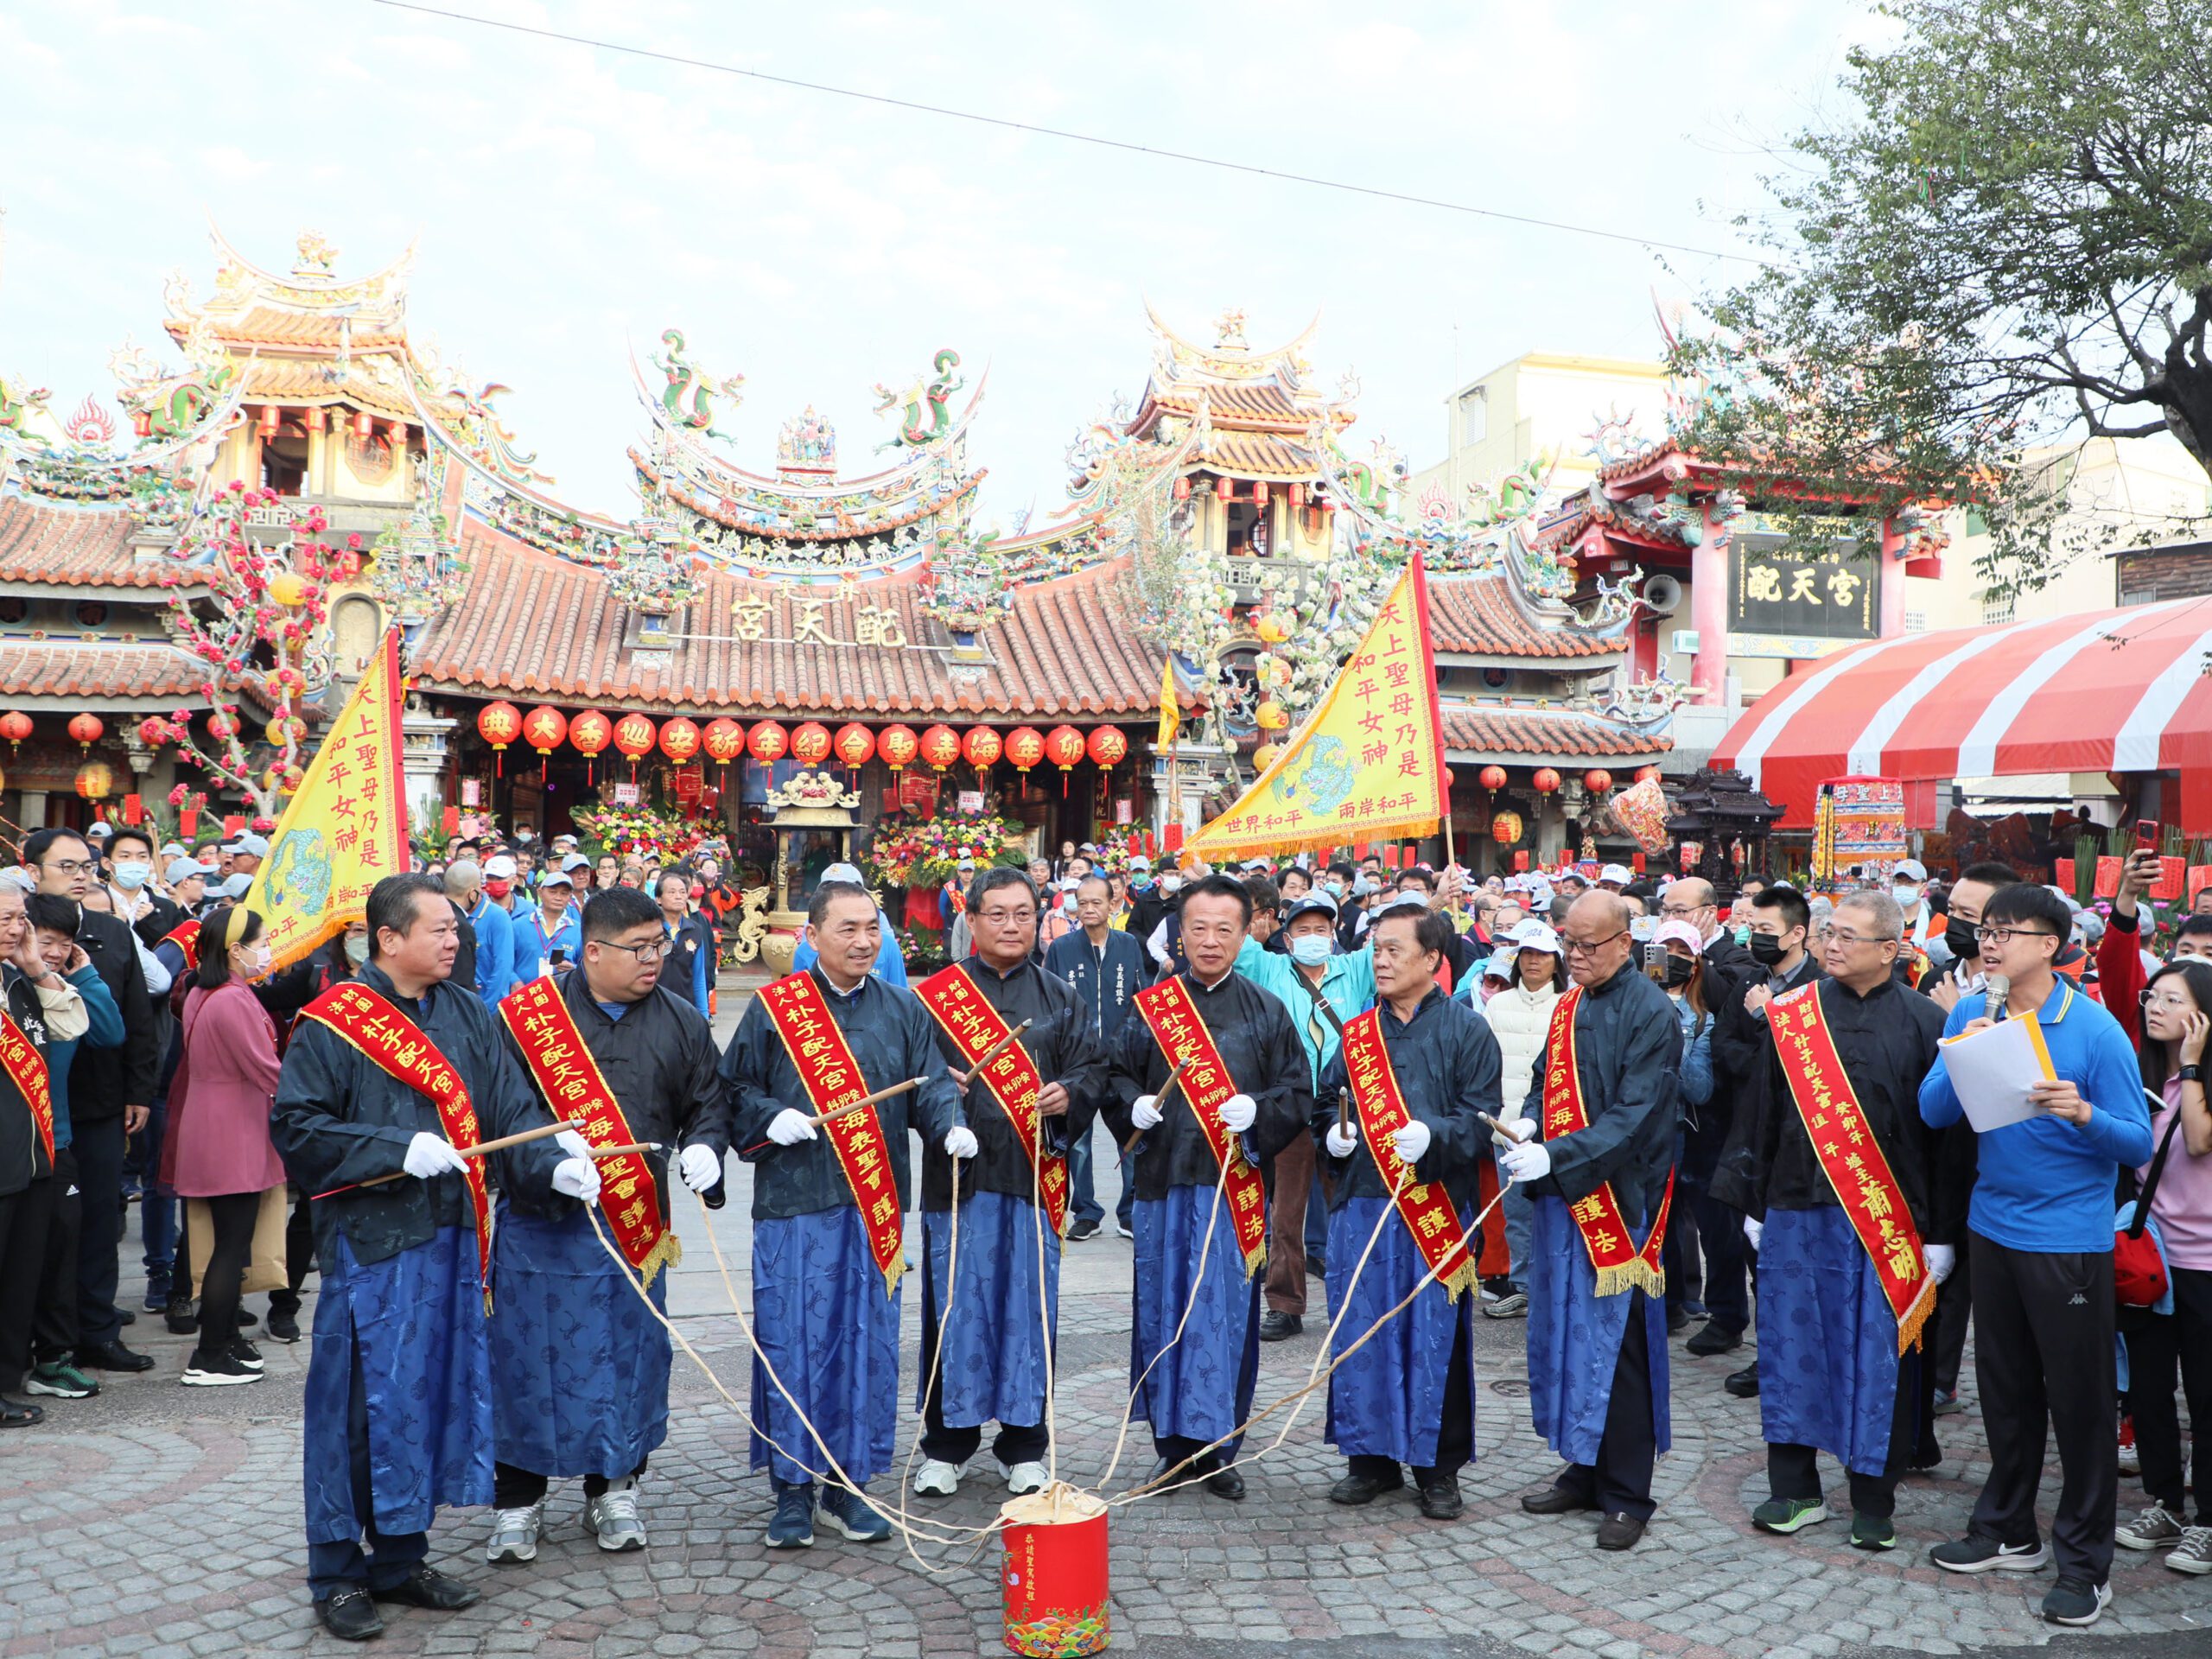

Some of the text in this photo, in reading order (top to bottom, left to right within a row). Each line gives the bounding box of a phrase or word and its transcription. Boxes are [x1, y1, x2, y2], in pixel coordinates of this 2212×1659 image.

[1747, 564, 1861, 607] 配天宮
[1353, 653, 1389, 767] 和平女神
[1380, 602, 1423, 779] 天上聖母乃是
[327, 736, 358, 853] 和平女神
[353, 683, 385, 868] 天上聖母乃是
[1224, 809, 1303, 834] 世界和平
[1338, 791, 1418, 820] 兩岸和平
[1524, 927, 1542, 938] 2024
[340, 988, 374, 1014] 財團
[511, 995, 532, 1016] 法人
[528, 982, 550, 1007] 財團
[771, 985, 794, 1007] 法人
[789, 980, 810, 1000] 財團
[934, 990, 956, 1012] 法人
[948, 979, 969, 1001] 財團
[1147, 995, 1165, 1016] 法人
[1161, 985, 1179, 1007] 財團
[327, 1001, 359, 1026] 法人
[1774, 1012, 1797, 1044] 法人
[1798, 1000, 1818, 1029] 財團
[361, 1014, 454, 1094] 朴子配天宮
[524, 1012, 589, 1101] 朴子配天宮
[786, 1004, 848, 1091] 朴子配天宮
[1160, 1012, 1217, 1089] 朴子配天宮
[1345, 1026, 1357, 1047] 法人
[1349, 1041, 1388, 1116] 朴子配天宮
[1794, 1033, 1833, 1109] 朴子配天宮
[1834, 1100, 1866, 1147] 癸卯年
[836, 1108, 883, 1191] 海表聖會
[873, 1193, 898, 1256] 護法
[1236, 1182, 1266, 1242] 護法
[1571, 1193, 1618, 1254] 護法
[1859, 1179, 1918, 1285] 蕭志明
